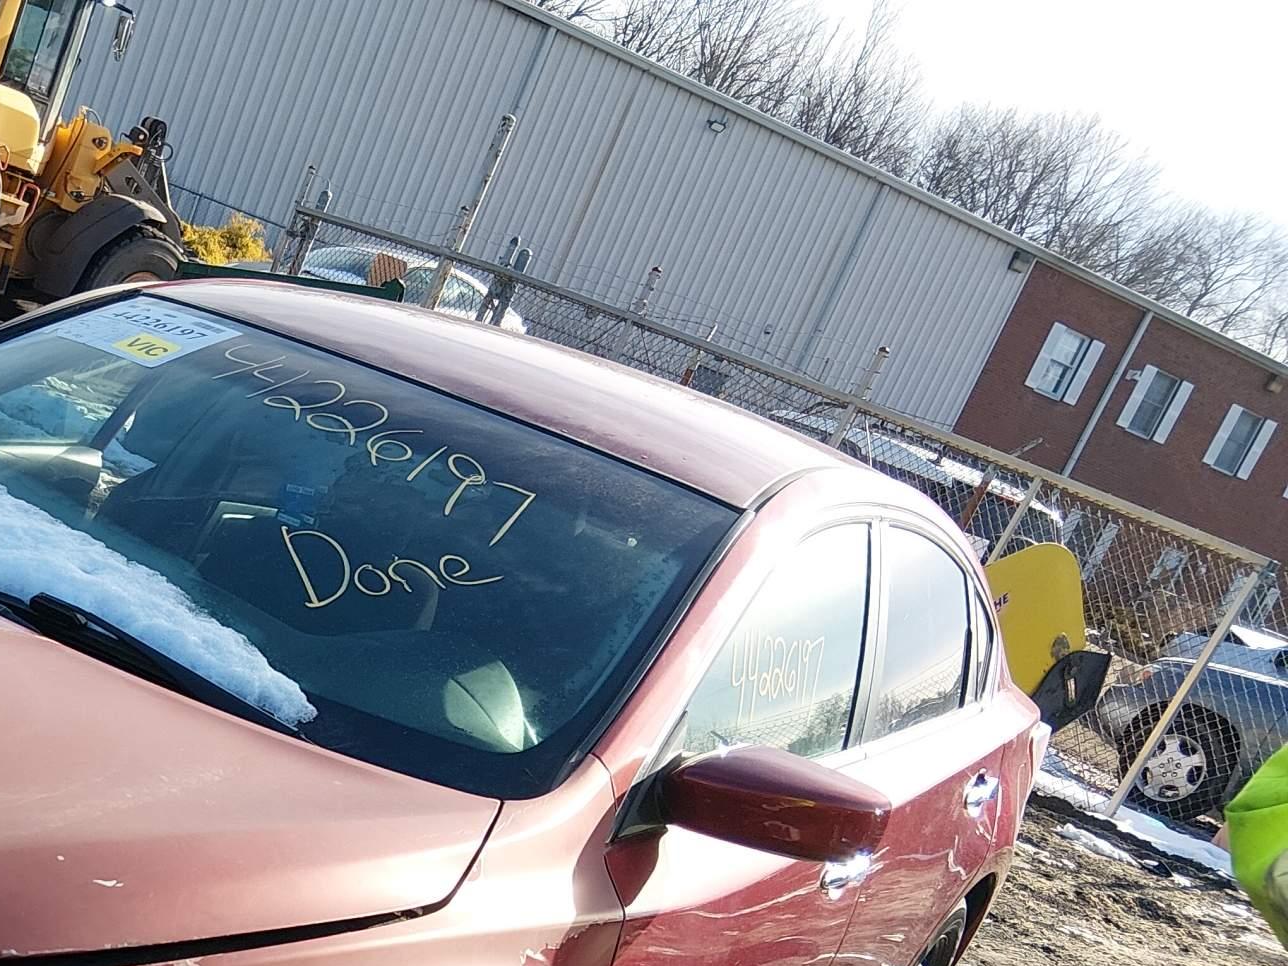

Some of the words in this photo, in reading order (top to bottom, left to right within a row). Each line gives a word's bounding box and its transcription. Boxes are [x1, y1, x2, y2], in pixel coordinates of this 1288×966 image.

[113, 311, 209, 340] 44226197
[126, 337, 169, 357] VIC
[212, 343, 537, 548] 44226197
[280, 525, 504, 609] Done
[730, 630, 825, 729] 44226197
